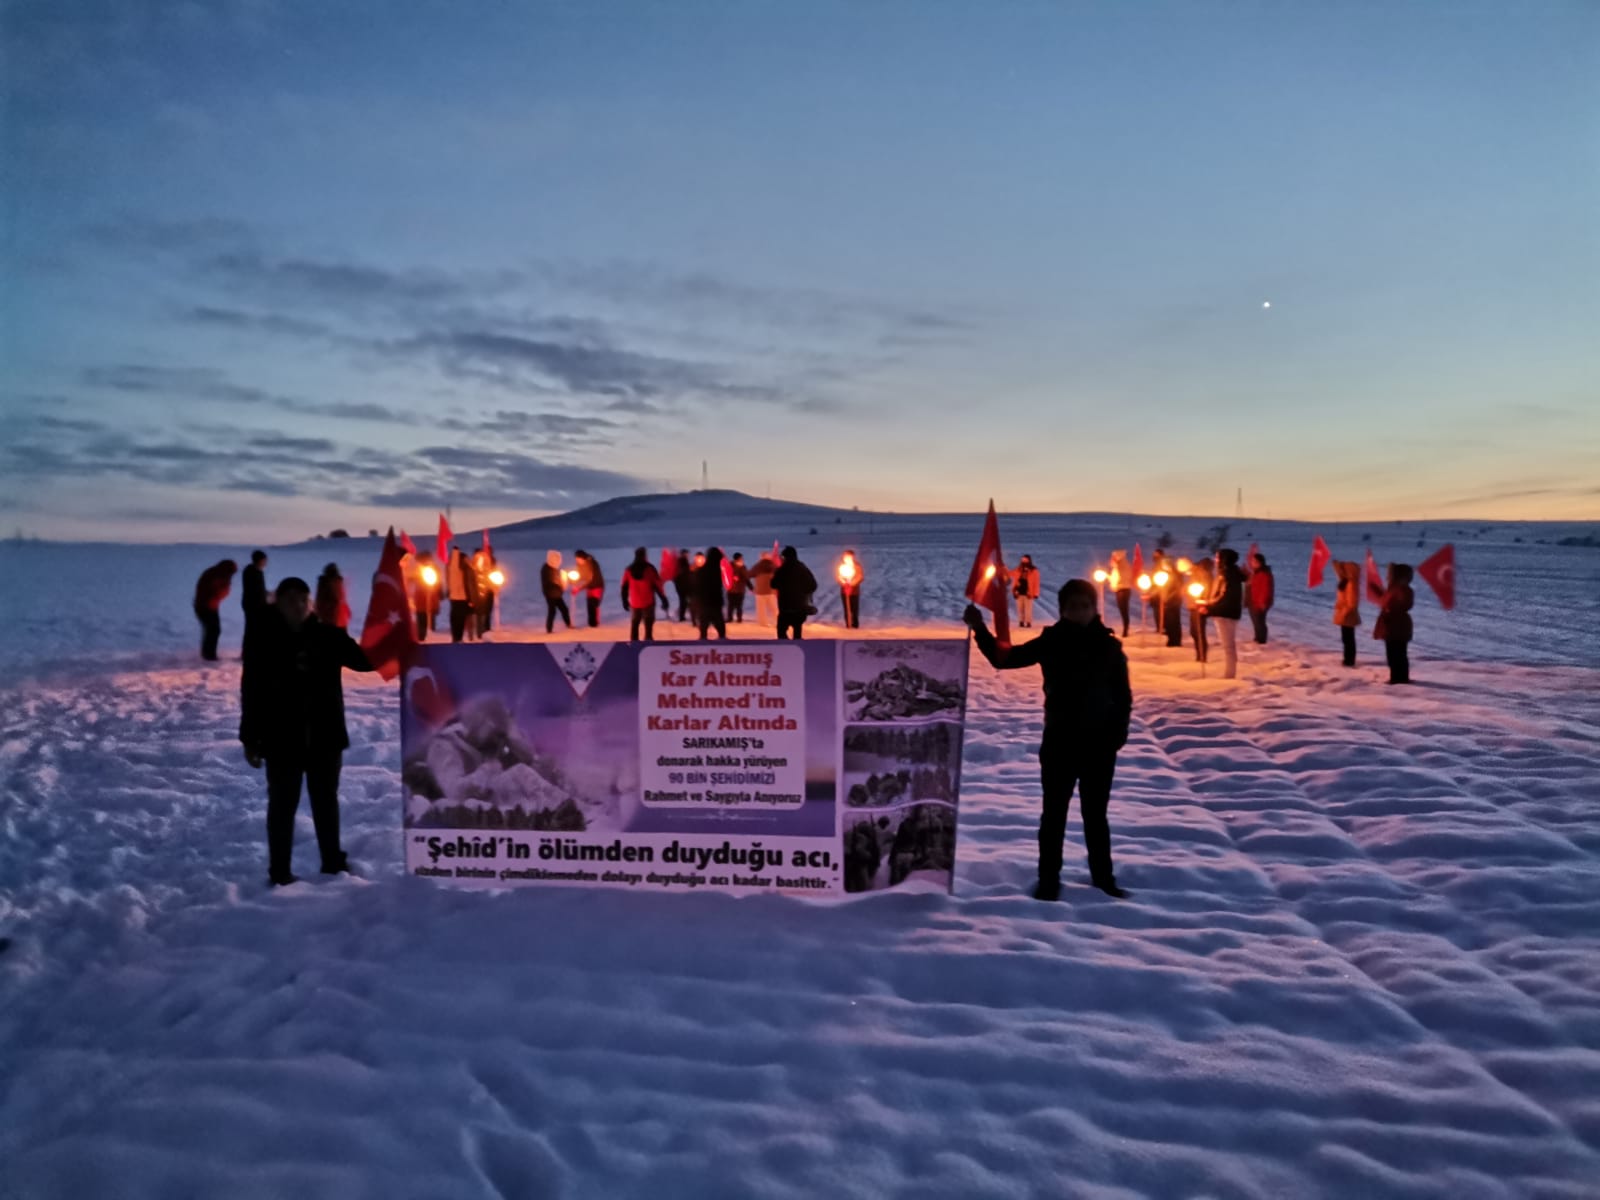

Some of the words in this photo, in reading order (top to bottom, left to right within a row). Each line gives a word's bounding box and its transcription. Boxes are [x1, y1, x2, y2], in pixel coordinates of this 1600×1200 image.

[669, 649, 773, 669] Sarıkamış
[661, 671, 697, 687] Kar
[704, 670, 782, 687] Altında
[657, 692, 786, 709] Mehmed'im
[648, 715, 712, 730] Karlar
[718, 715, 798, 730] Altında
[657, 755, 704, 767] donarak
[706, 755, 741, 767] hakka
[743, 755, 787, 769] yürüyen
[669, 772, 684, 784] 90
[687, 771, 707, 784] BİN
[644, 790, 688, 802] Rahmet
[691, 793, 703, 802] ve
[754, 791, 802, 805] Anıyoruz
[538, 838, 654, 862] ölümden
[662, 840, 783, 872] duyduğu
[791, 849, 839, 871] acı,
[601, 869, 642, 885] dolayı
[646, 872, 706, 887] duyduğu
[709, 875, 729, 886] acı
[733, 873, 772, 887] kadar
